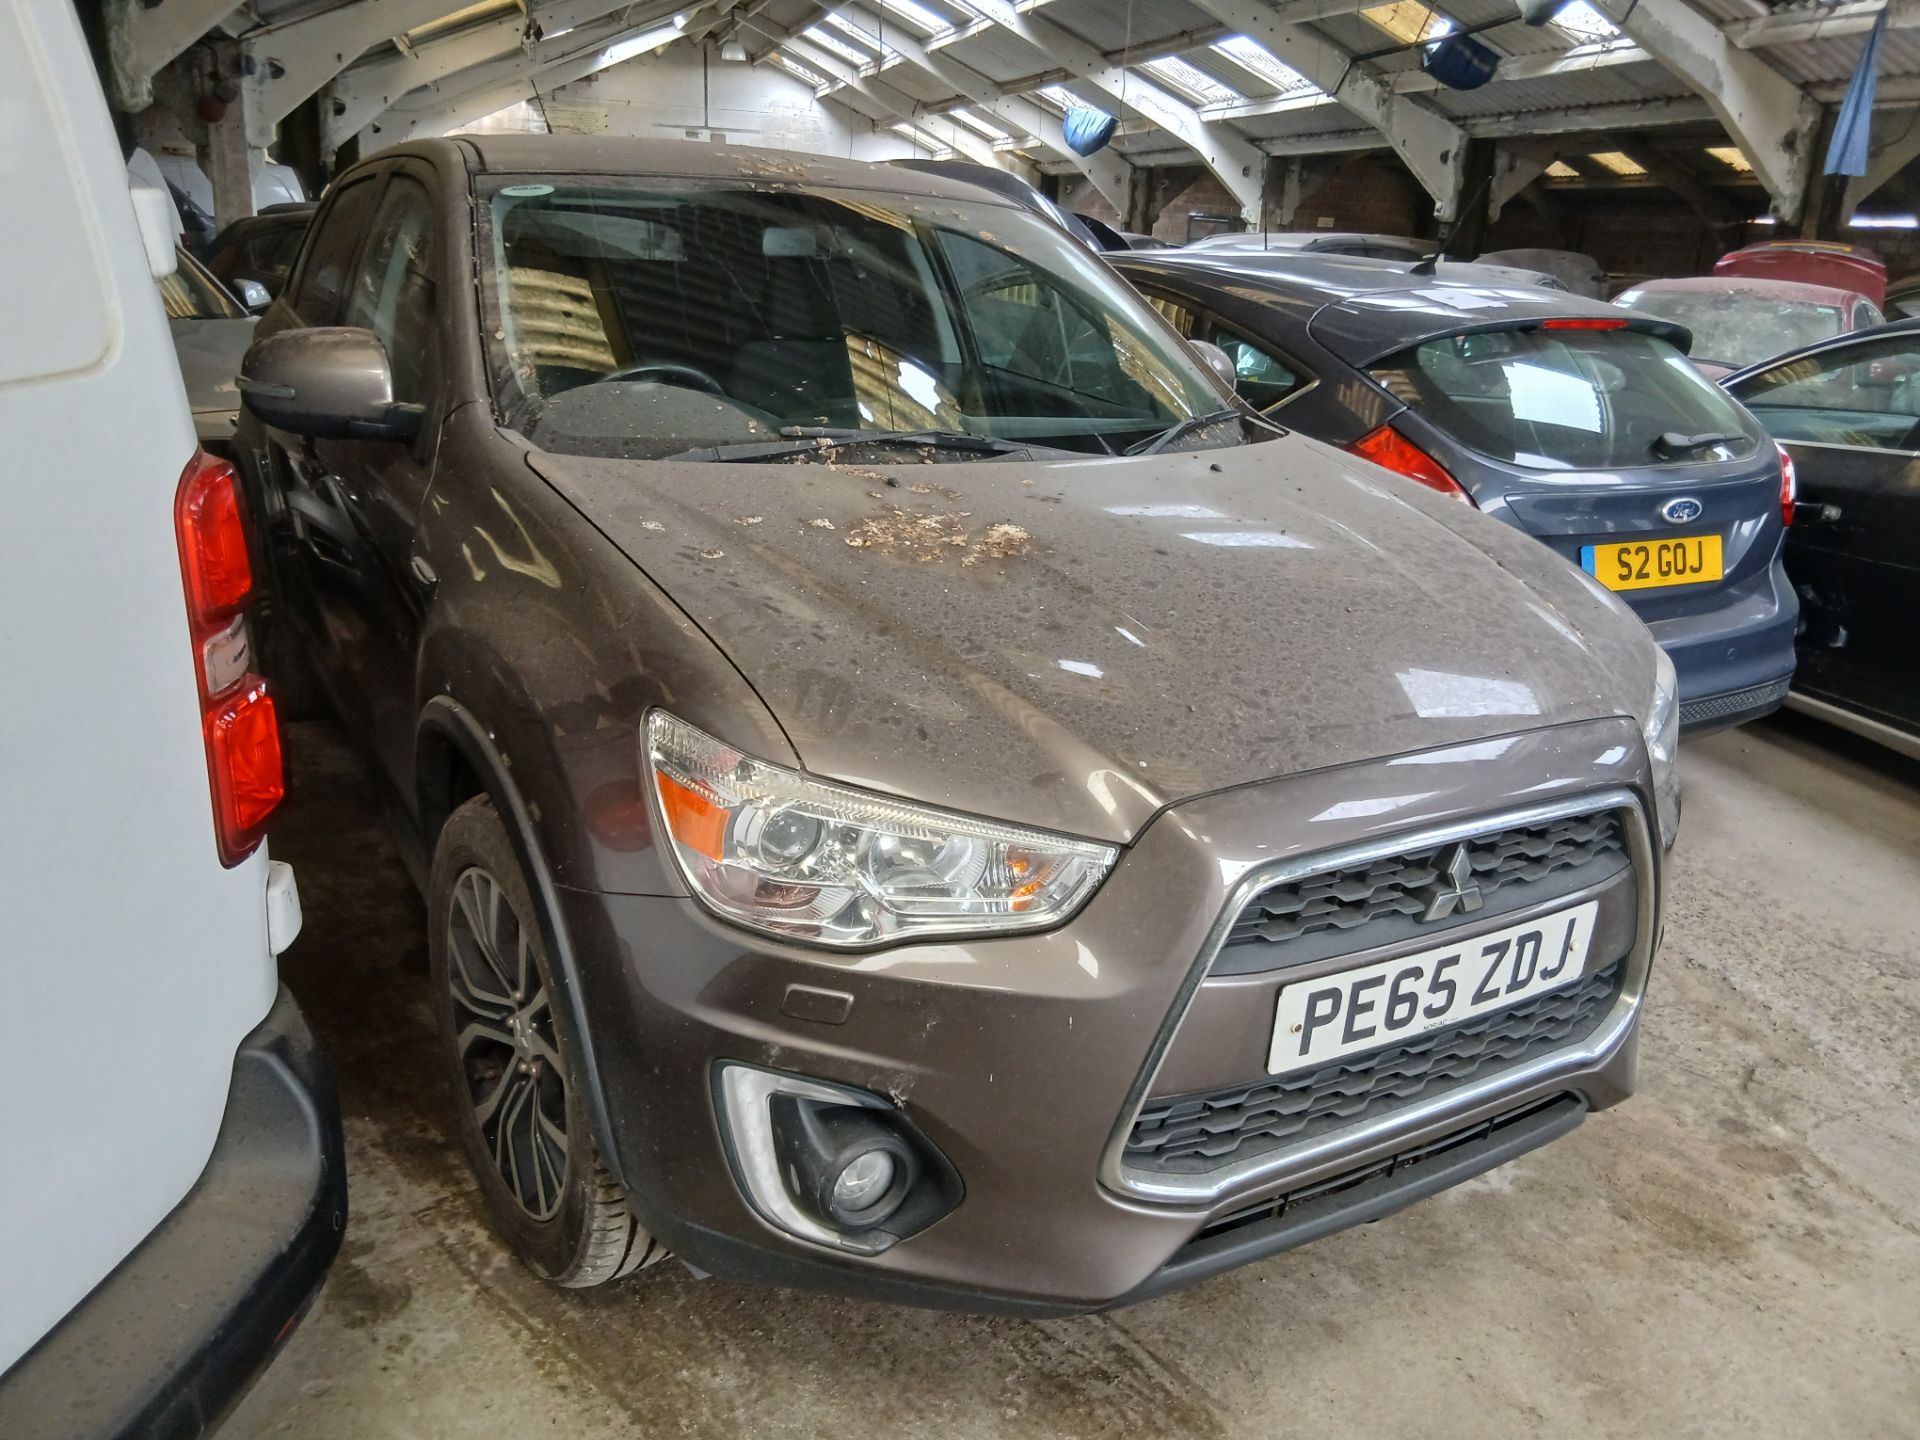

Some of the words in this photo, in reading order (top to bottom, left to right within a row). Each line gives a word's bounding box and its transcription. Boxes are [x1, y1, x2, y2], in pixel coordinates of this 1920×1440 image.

[1672, 502, 1696, 518] Ford
[1617, 545, 1650, 581] S2
[1657, 540, 1703, 577] GOJ
[1298, 954, 1461, 1057] PE65
[1470, 917, 1577, 1007] ZDJ
